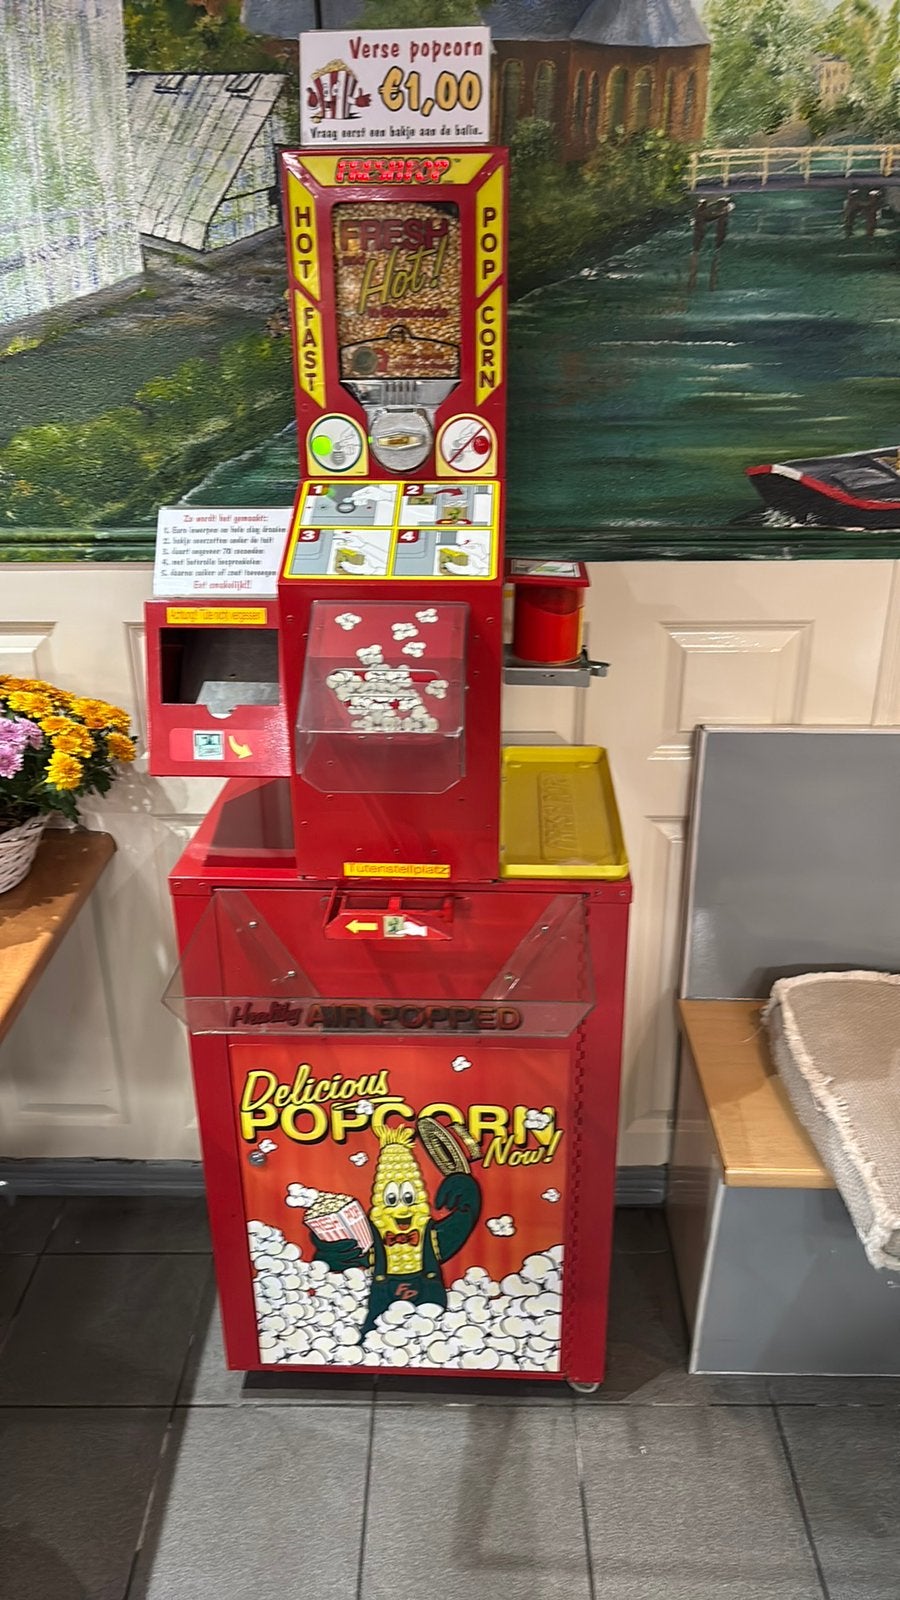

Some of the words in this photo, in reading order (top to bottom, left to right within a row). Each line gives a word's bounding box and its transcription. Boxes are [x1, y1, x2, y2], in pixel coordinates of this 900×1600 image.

[350, 37, 400, 60] Verse
[410, 40, 483, 63] popcorn
[378, 66, 482, 117] €1,00
[310, 127, 338, 140] Vraag
[342, 127, 366, 138] eerst
[370, 128, 386, 138] een
[390, 125, 416, 140] bakje
[420, 127, 436, 137] aan
[440, 124, 451, 136] de
[294, 206, 313, 280] HOT
[338, 218, 449, 252] FRESH
[480, 206, 498, 280] POP
[358, 236, 449, 316] Hot!
[301, 307, 318, 392] FAST
[478, 306, 497, 389] CORN
[312, 485, 324, 495] 1
[405, 485, 421, 495] 2
[301, 530, 317, 541] 3
[400, 531, 415, 542] 4
[305, 1004, 366, 1029] AIR
[373, 1004, 524, 1031] POPPED
[241, 1062, 391, 1113] Delicious
[482, 1129, 564, 1169] Now!
